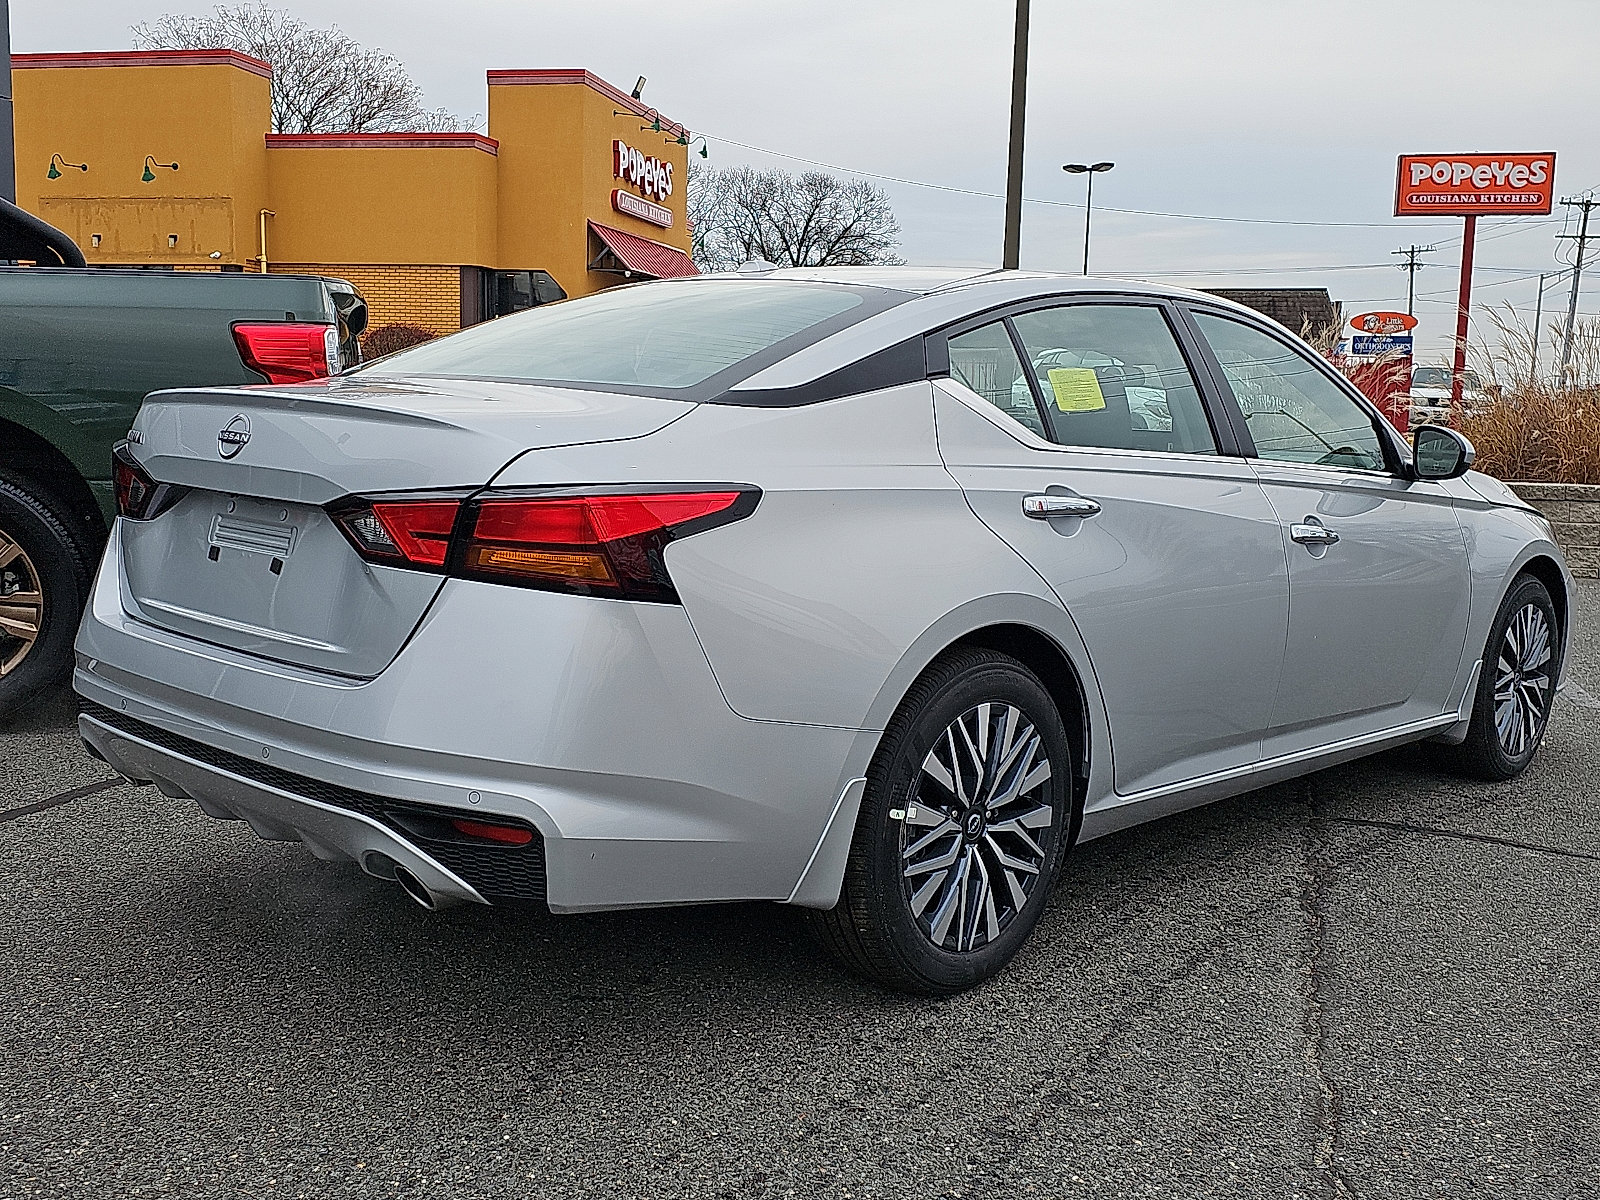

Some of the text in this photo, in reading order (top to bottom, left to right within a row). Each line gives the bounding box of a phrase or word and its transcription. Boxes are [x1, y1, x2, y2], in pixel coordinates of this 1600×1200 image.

[1411, 194, 1539, 204] LOUISIANA KITCHEN
[1385, 317, 1403, 325] Little
